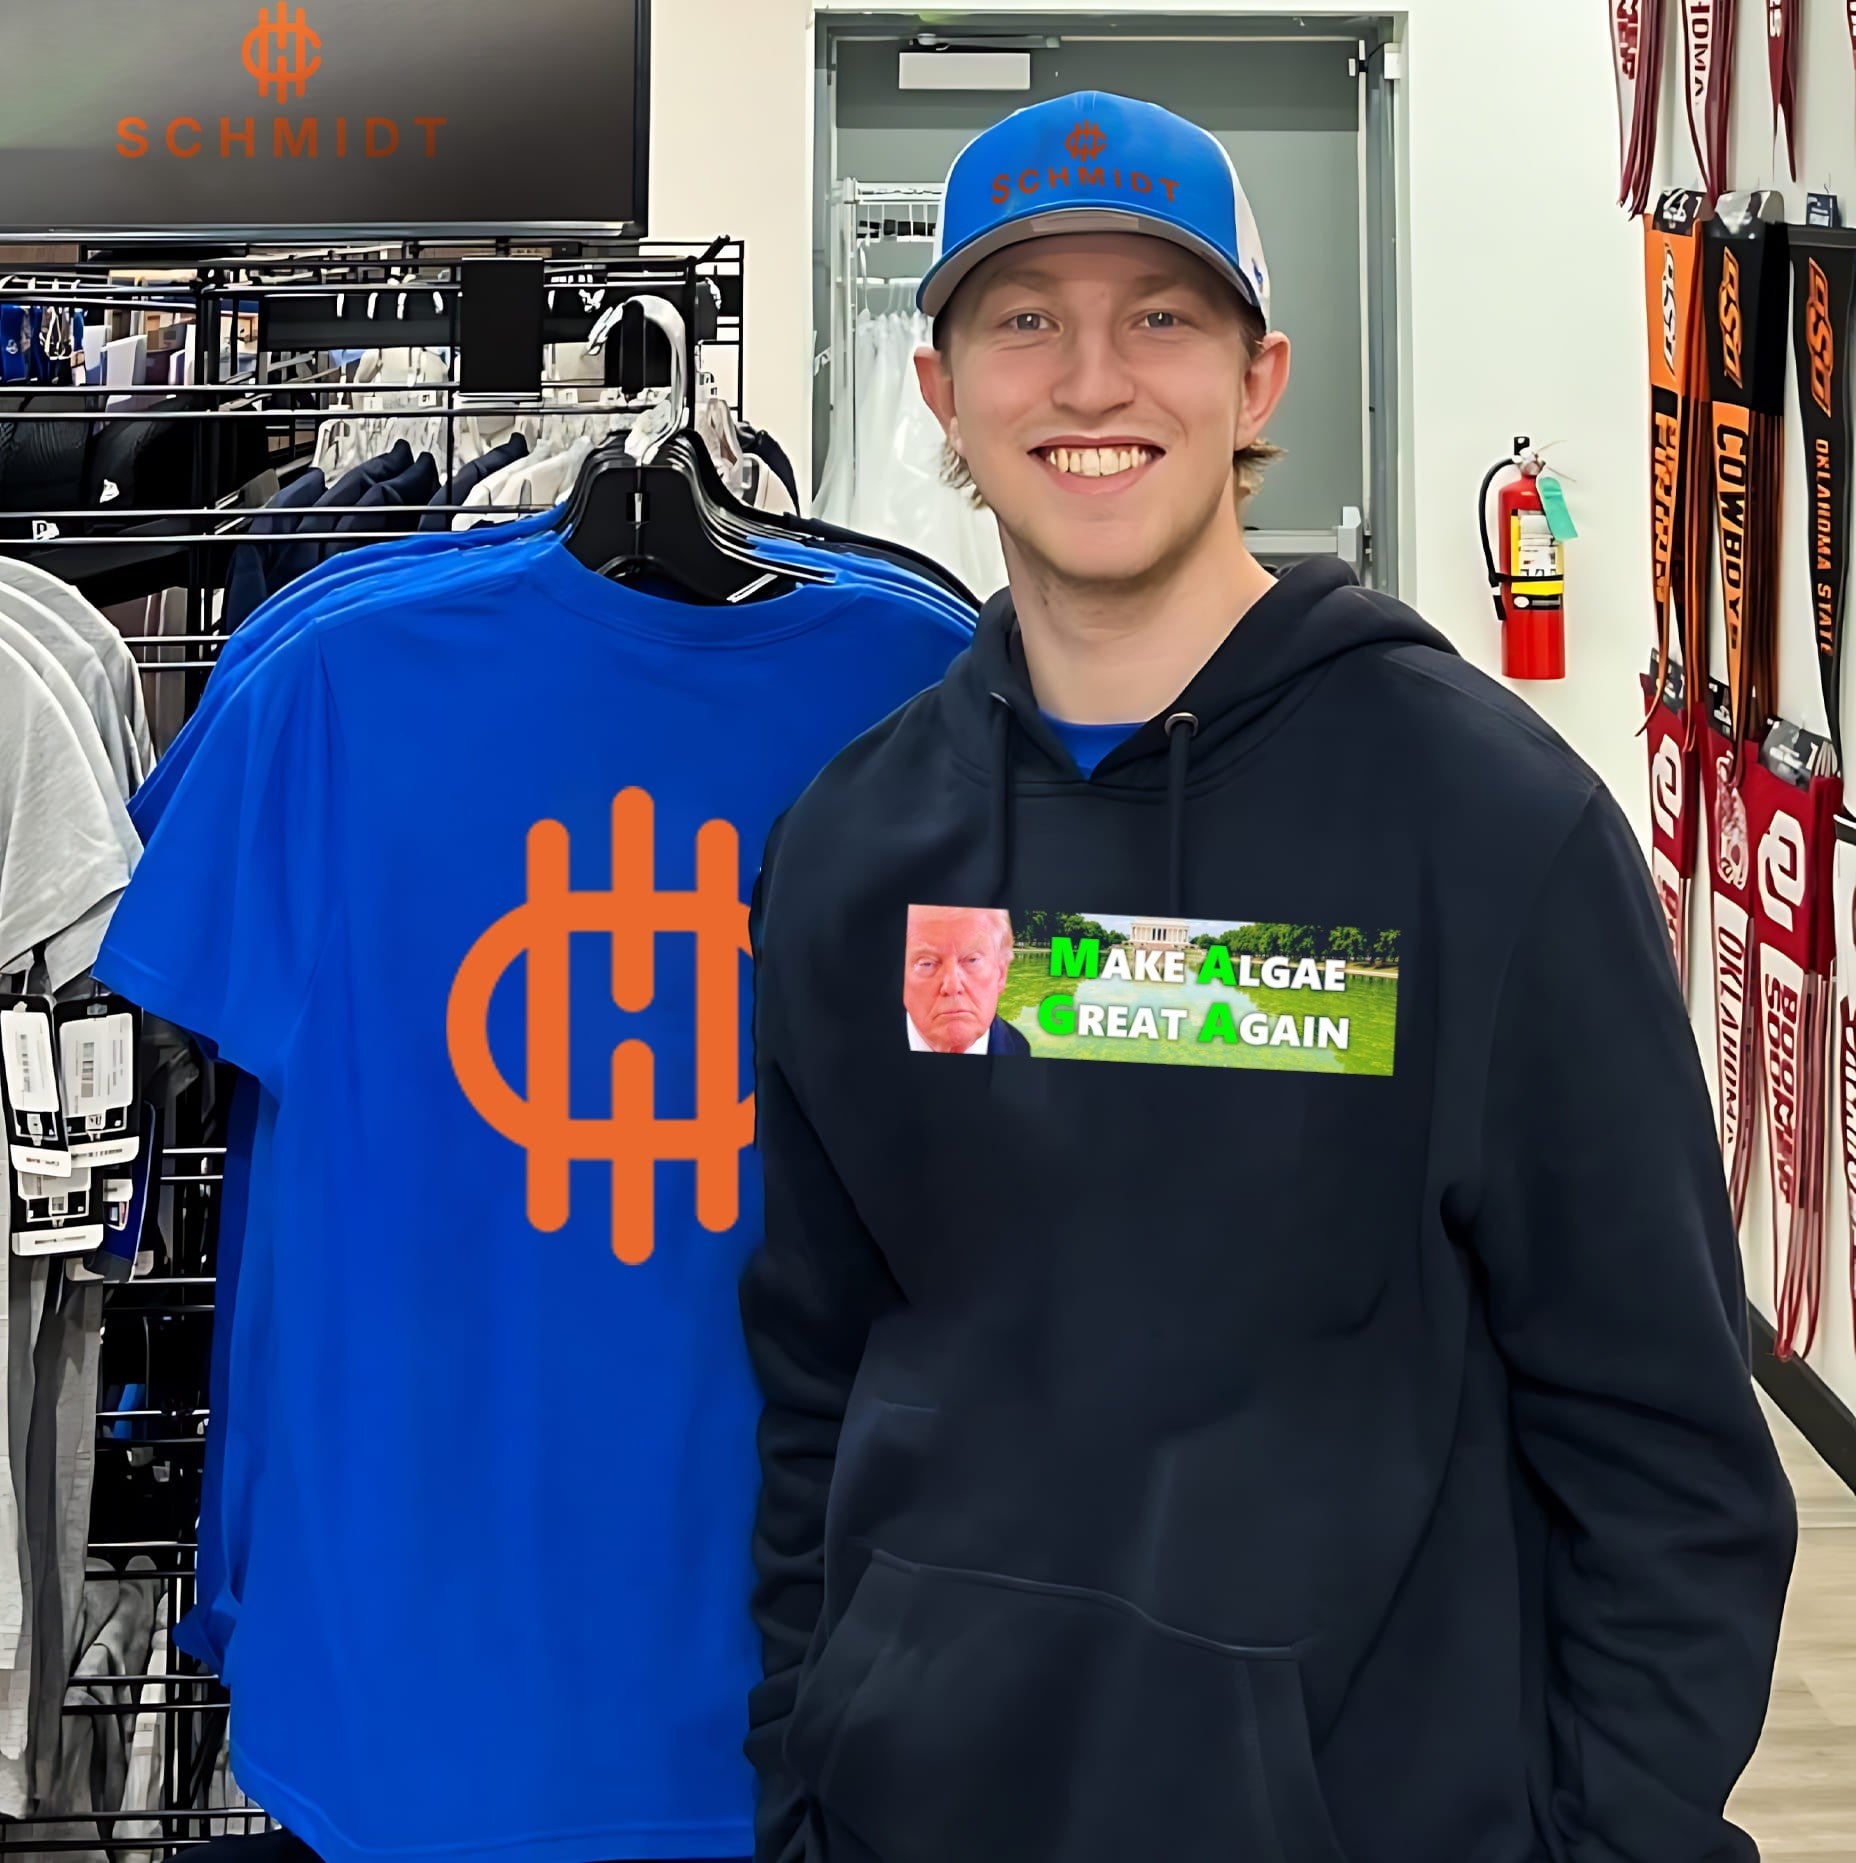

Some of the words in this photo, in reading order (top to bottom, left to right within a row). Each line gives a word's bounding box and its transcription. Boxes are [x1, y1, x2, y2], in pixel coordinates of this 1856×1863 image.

[116, 116, 448, 159] SCHMIDT
[991, 167, 1179, 205] SCHMIDT
[1815, 438, 1832, 570] OKLAHOMA
[1049, 936, 1185, 983] MAKE
[1197, 944, 1347, 992] ALGAE
[1037, 993, 1187, 1040] GREAT
[1199, 1002, 1349, 1049] AGAIN
